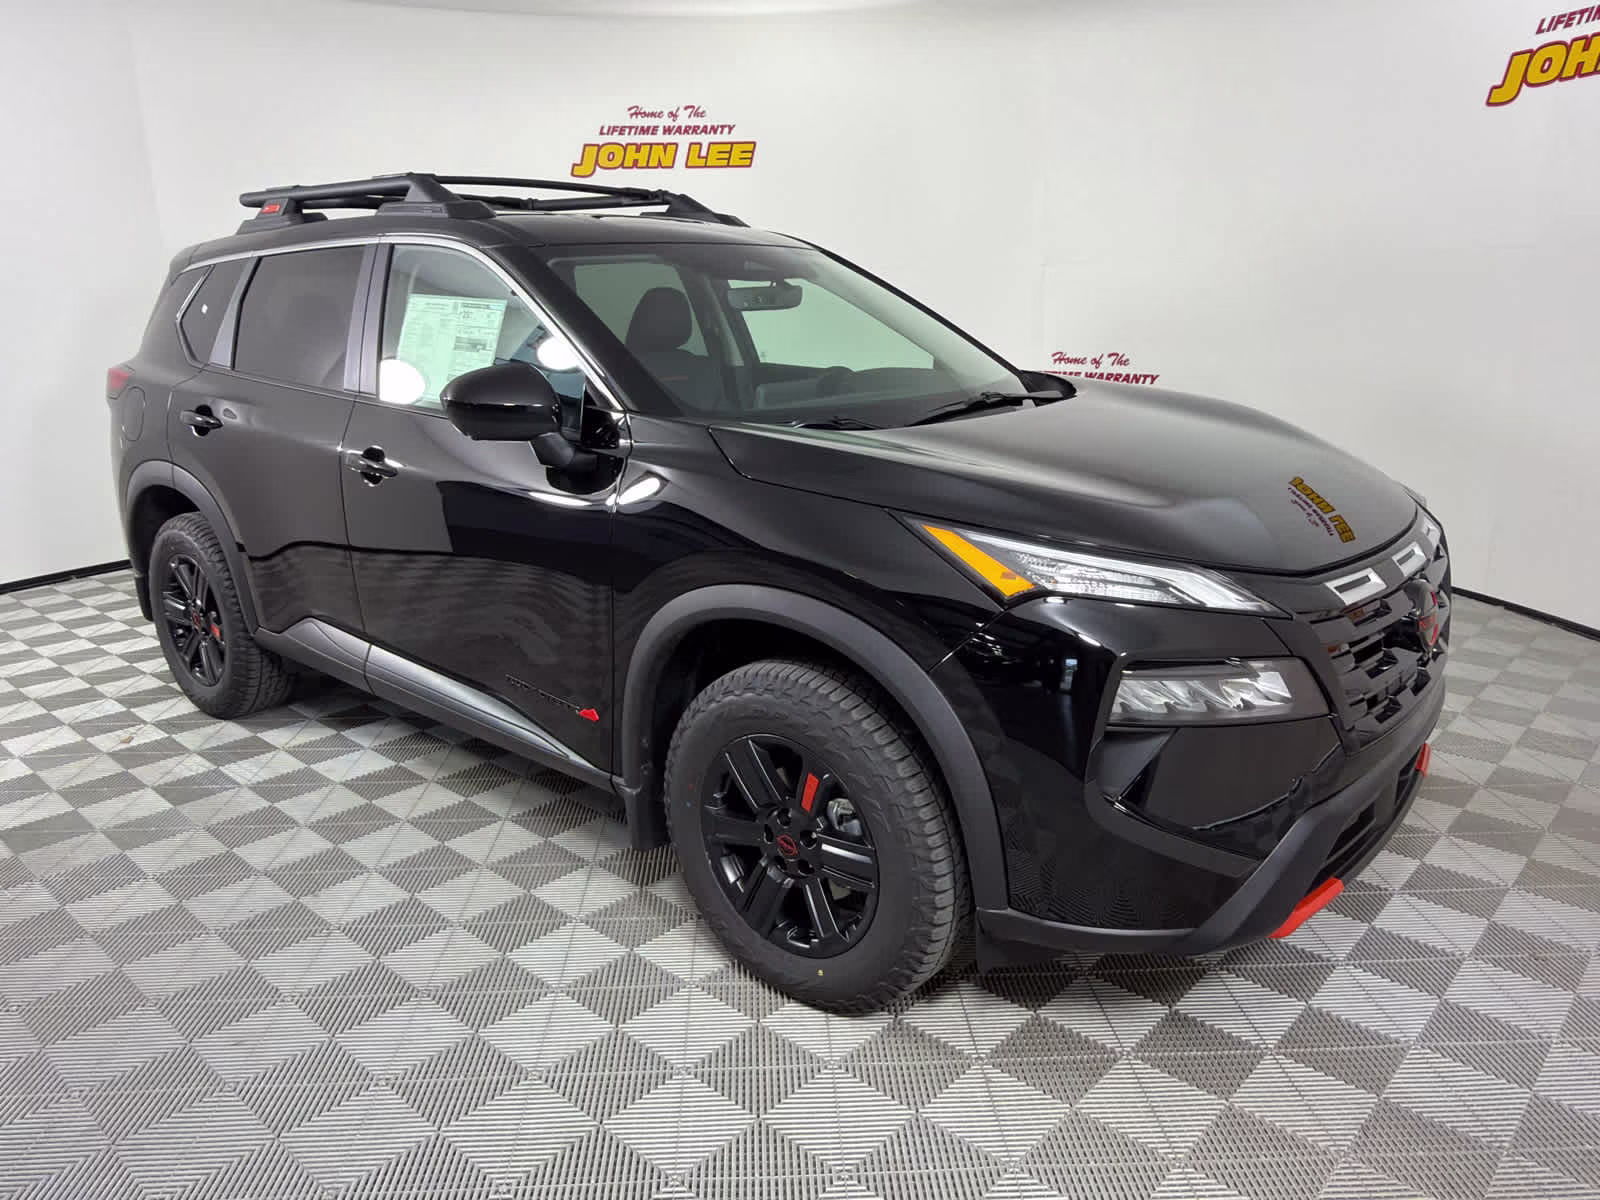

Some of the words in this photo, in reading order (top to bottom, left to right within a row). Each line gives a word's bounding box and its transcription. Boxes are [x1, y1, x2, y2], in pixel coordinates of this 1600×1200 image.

[1486, 32, 1600, 107] JOH
[627, 105, 664, 119] Home
[667, 107, 680, 122] of
[683, 105, 706, 118] The
[599, 125, 659, 136] LIFETIME
[662, 124, 736, 136] WARRANTY
[570, 142, 679, 178] JOHN
[685, 141, 757, 169] LEE
[1051, 351, 1088, 366] Home
[1090, 353, 1104, 369] of
[1107, 352, 1131, 367] The
